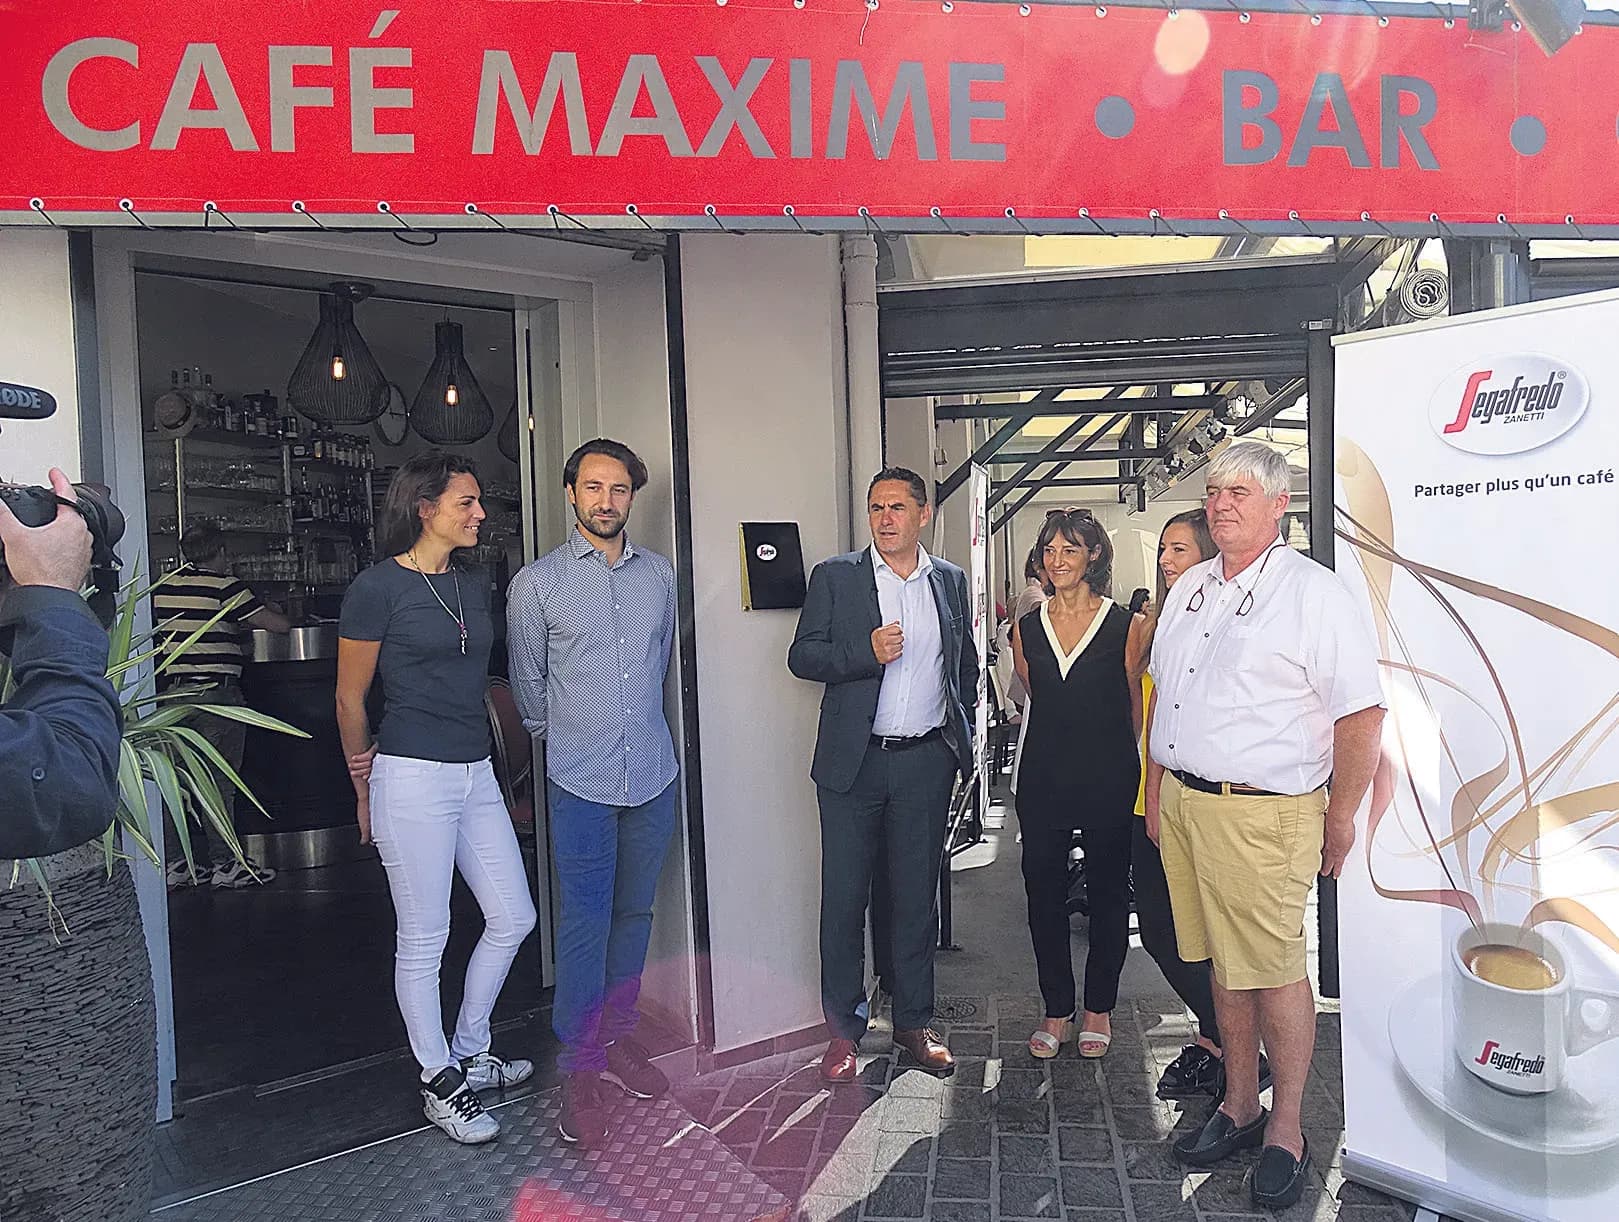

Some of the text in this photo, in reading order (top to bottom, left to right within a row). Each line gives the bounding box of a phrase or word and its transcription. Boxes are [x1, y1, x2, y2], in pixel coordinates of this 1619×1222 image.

[41, 10, 1440, 171] CAFÉ MAXIME BAR
[1443, 370, 1564, 434] Segafredo
[1503, 412, 1545, 424] ZANETTI
[1414, 468, 1615, 497] Partager plus qu'un café
[1475, 1040, 1545, 1074] Segafredo
